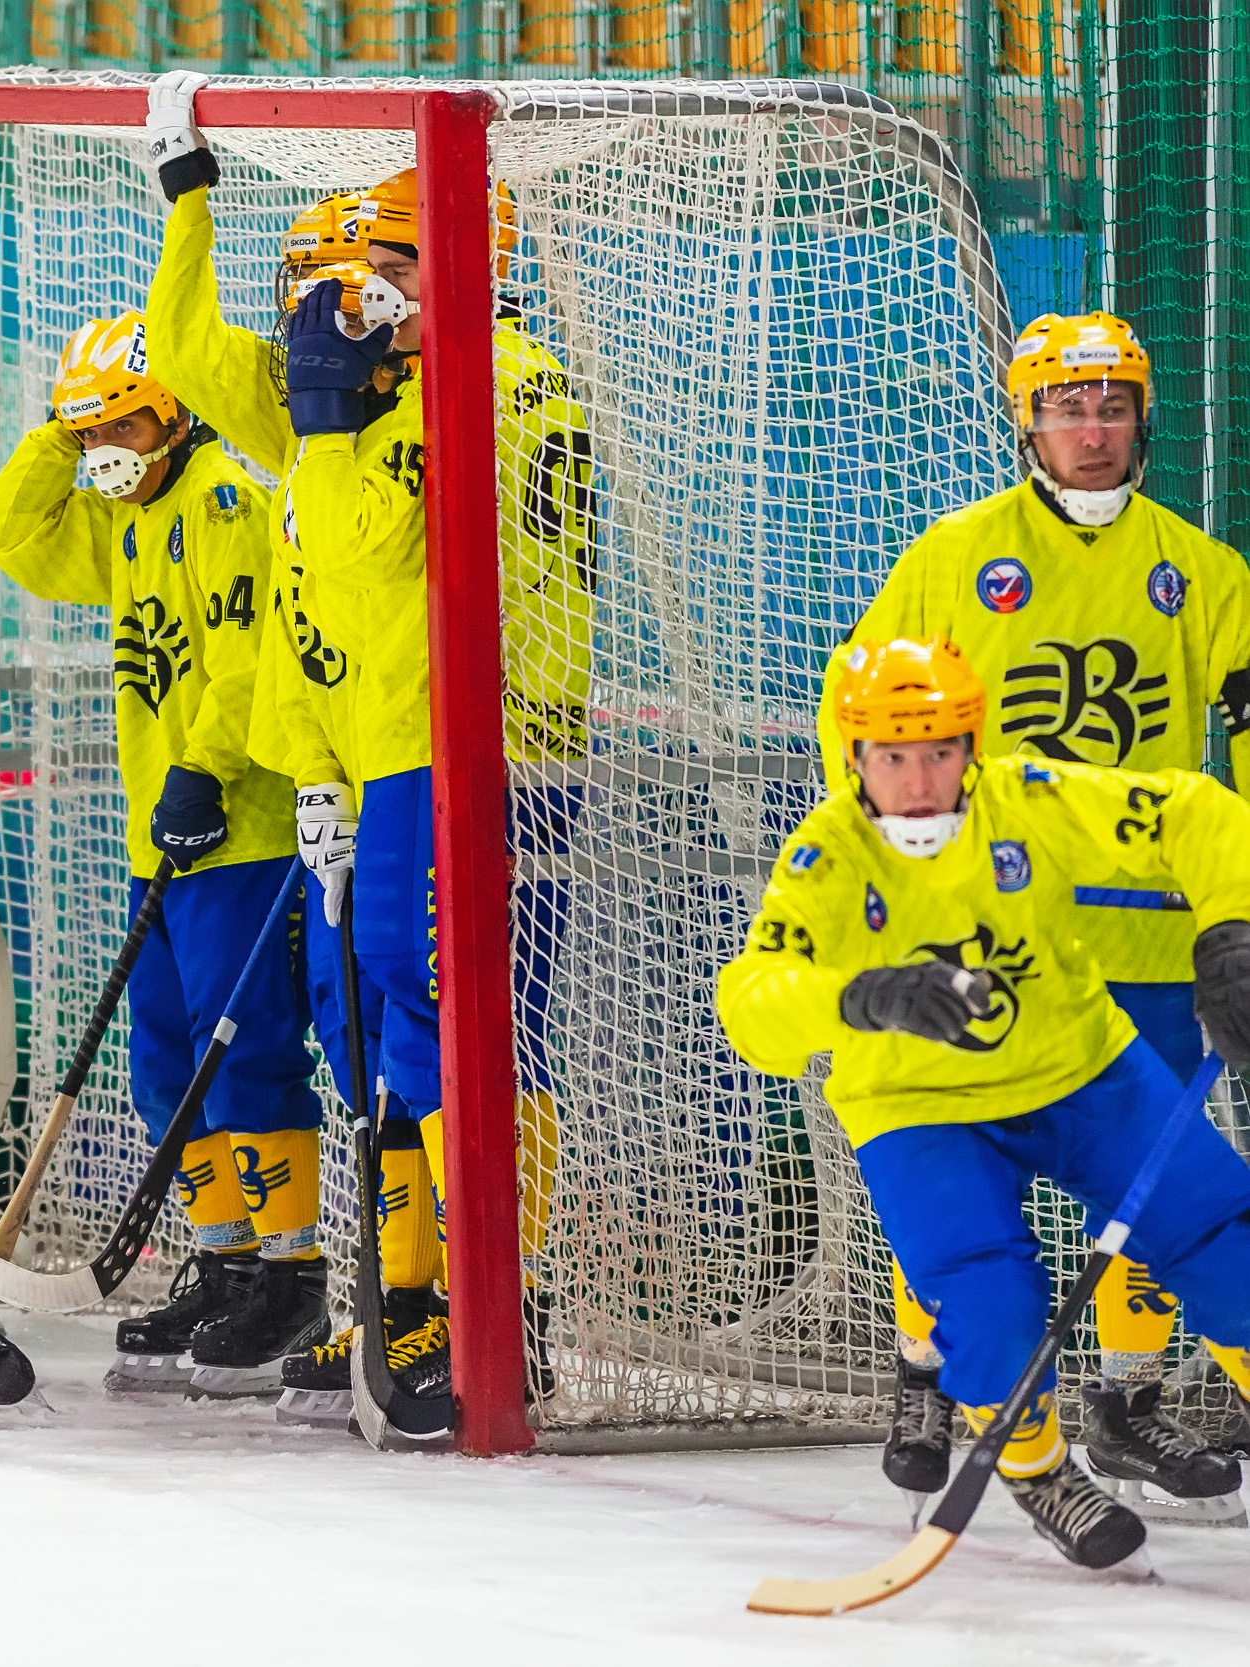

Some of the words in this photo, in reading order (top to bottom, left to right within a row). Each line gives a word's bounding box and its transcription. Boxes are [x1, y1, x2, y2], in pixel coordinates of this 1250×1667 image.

[290, 238, 318, 247] ŠKODA
[70, 400, 103, 414] ŠKODA
[162, 826, 225, 847] CCM
